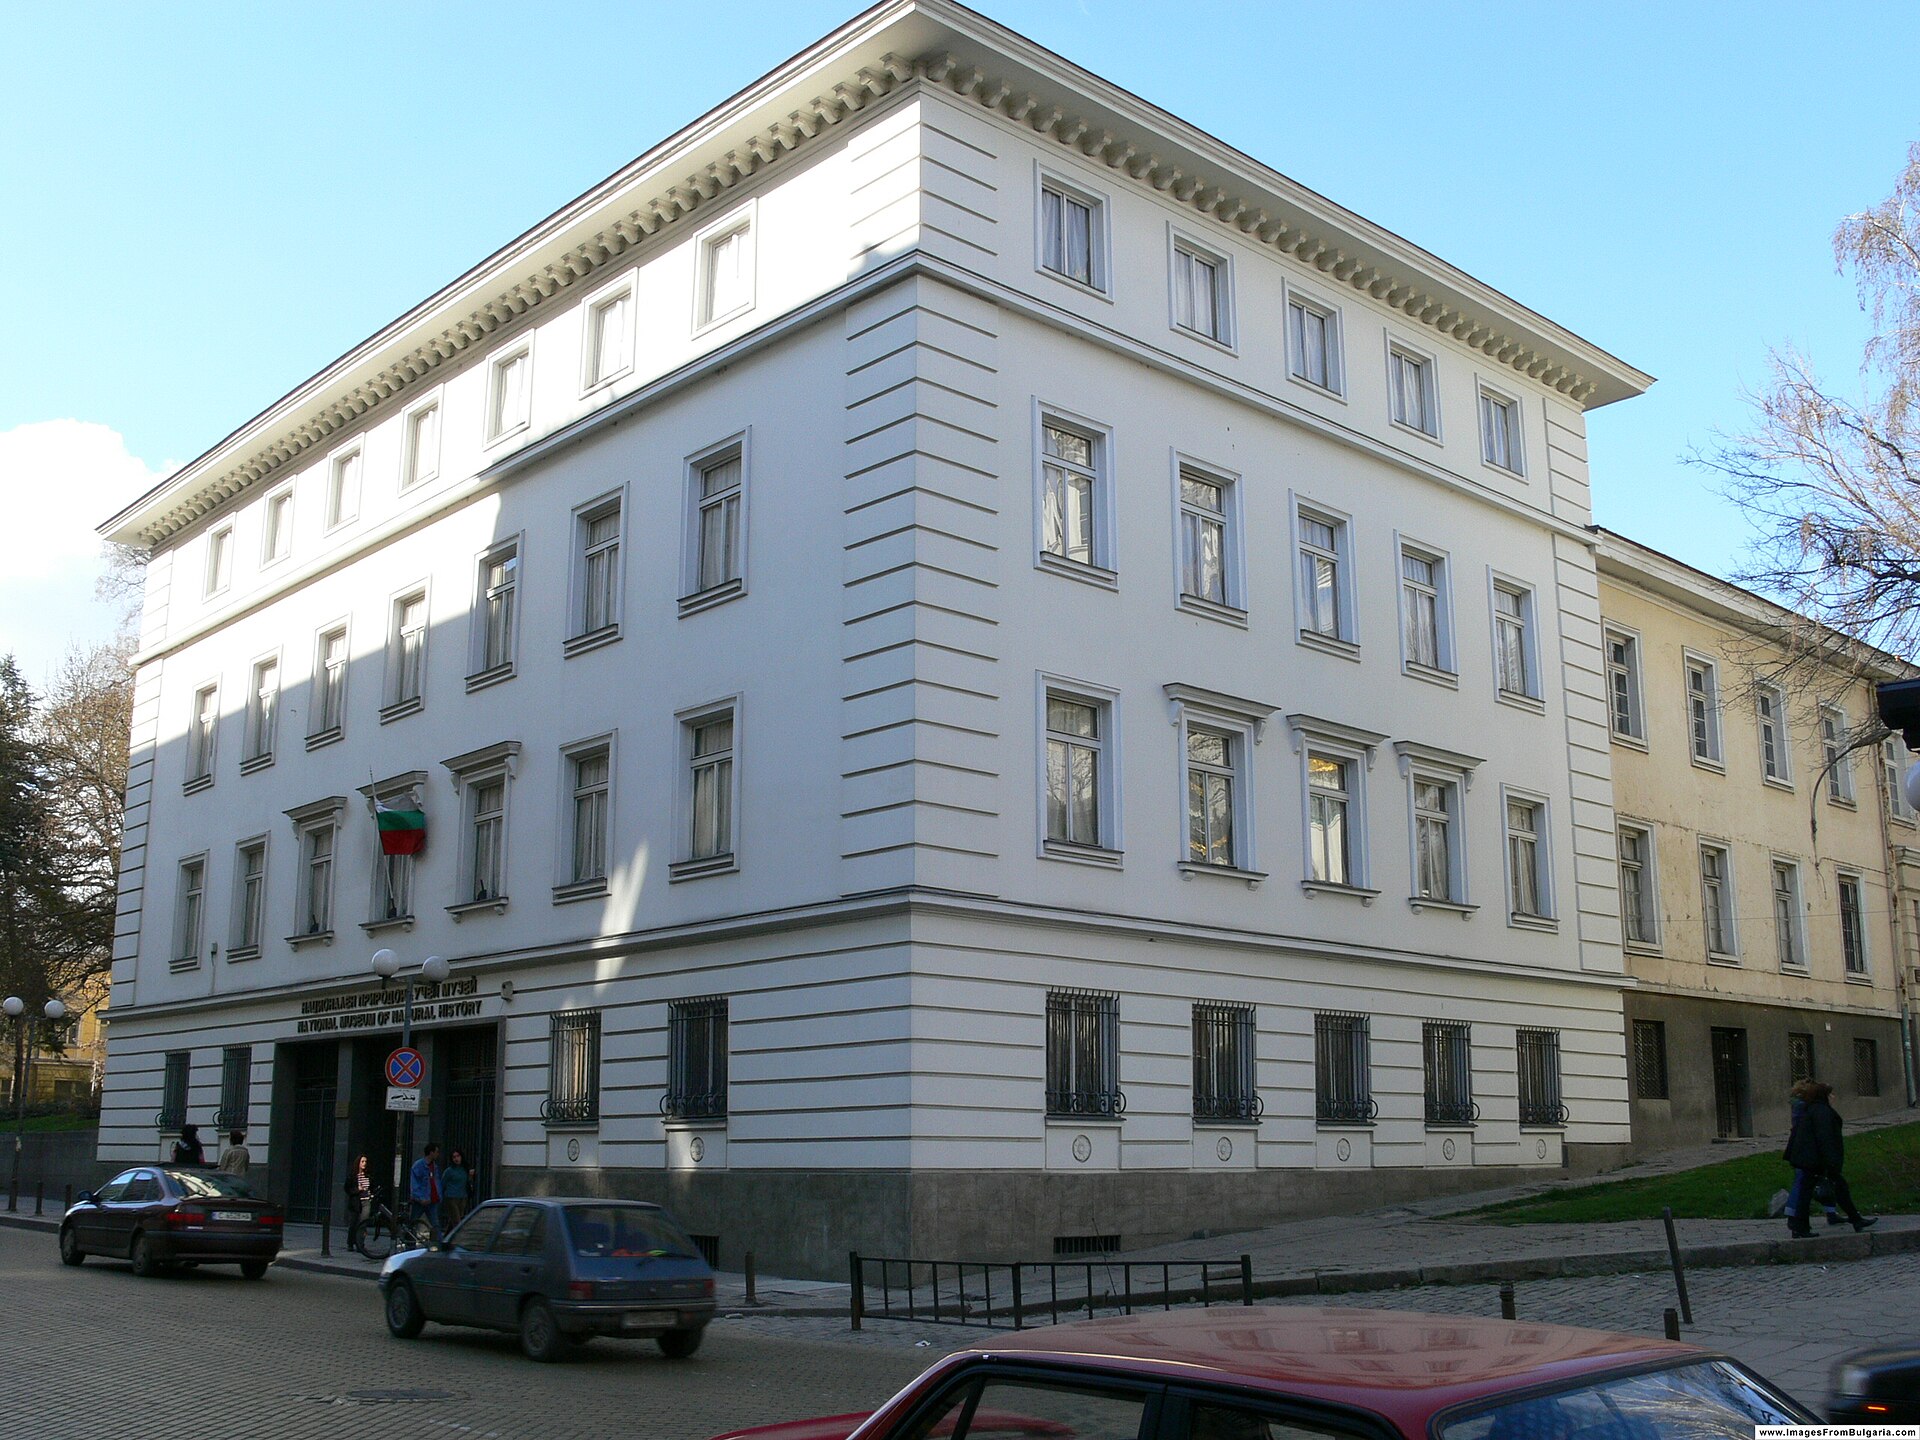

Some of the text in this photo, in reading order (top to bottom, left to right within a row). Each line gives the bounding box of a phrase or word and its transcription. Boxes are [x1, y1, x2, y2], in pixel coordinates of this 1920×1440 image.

[301, 976, 478, 1014] НАЦИОНАЛЕН ПРИРОДОНУЧЕН МУЗЕЙ
[297, 1000, 482, 1033] NATIONAL MUSEUM OF NAURAL HISTORY
